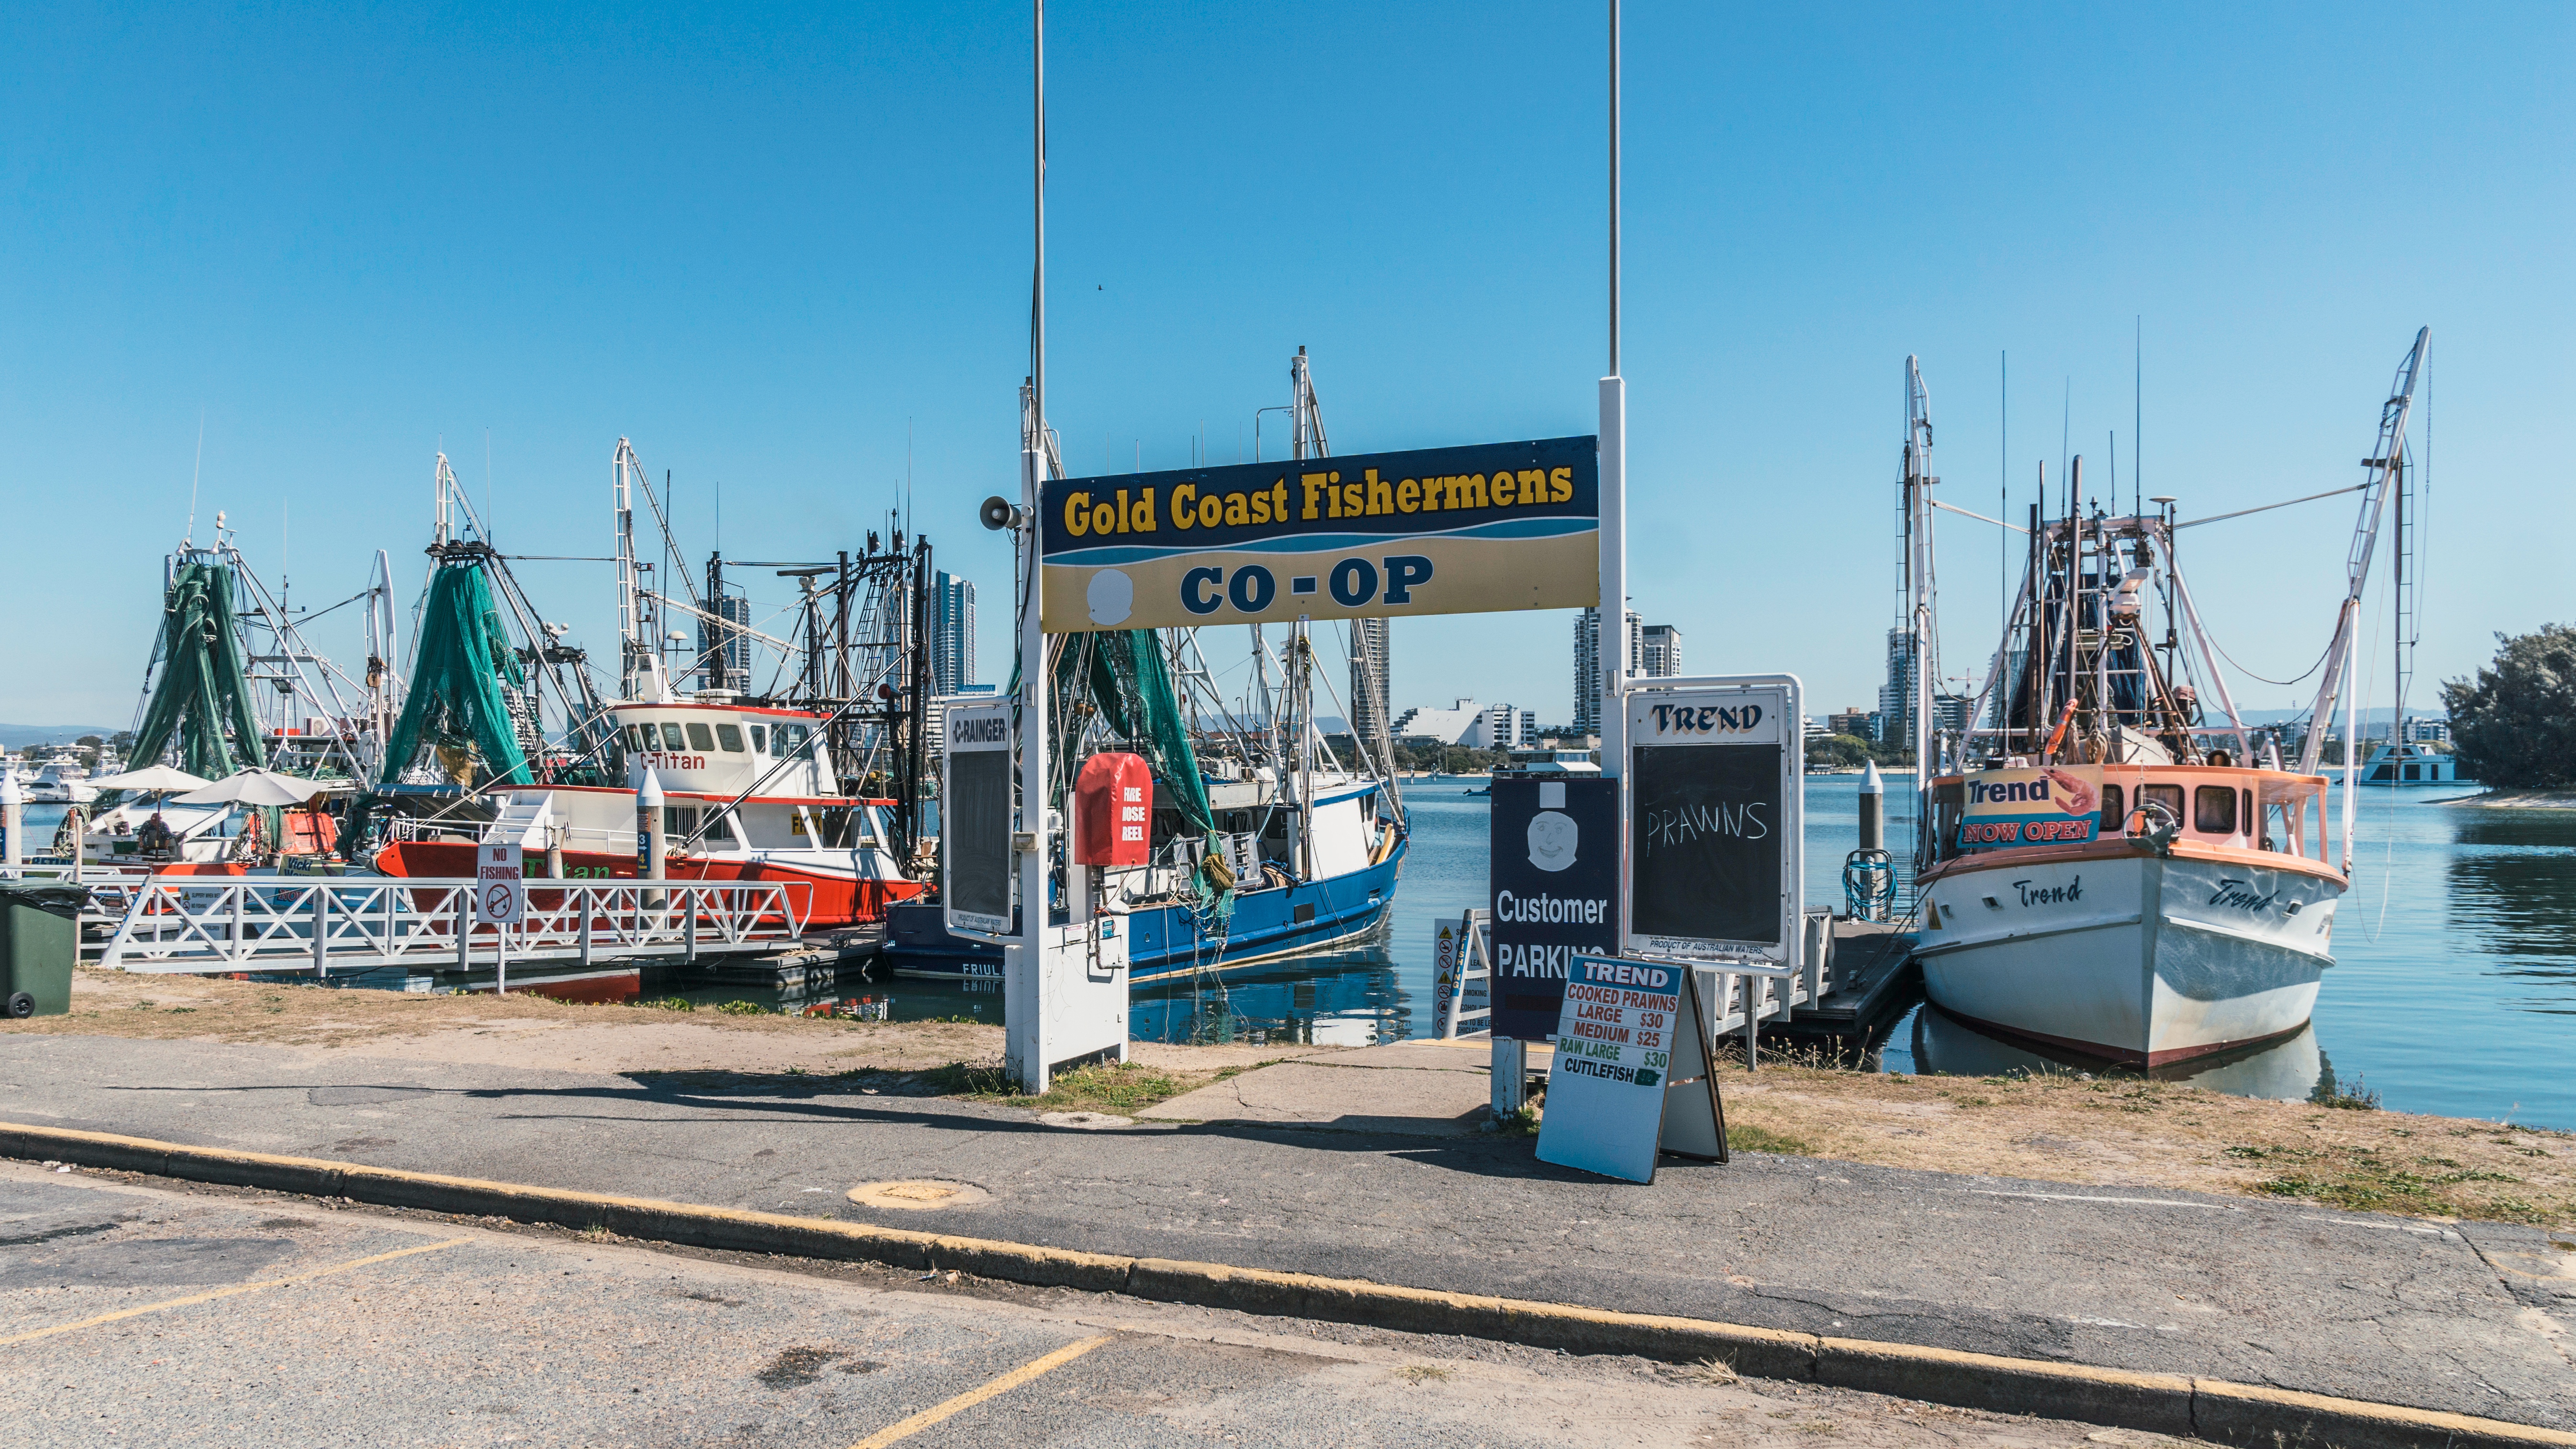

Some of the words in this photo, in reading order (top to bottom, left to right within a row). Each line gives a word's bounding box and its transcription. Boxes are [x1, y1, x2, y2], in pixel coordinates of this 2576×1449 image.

[1064, 487, 1157, 537] Gold
[1171, 483, 1288, 531] Coast
[1302, 464, 1573, 519] Fishermens
[955, 718, 1005, 744] C-RAINGER
[1650, 704, 1763, 735] TREND
[640, 752, 705, 770] C-Titan
[1123, 787, 1142, 802] FIRE
[1968, 775, 2050, 804] Trend
[1122, 806, 1145, 822] HOSE
[638, 834, 646, 845] 3
[1122, 826, 1144, 841] REEL
[1647, 801, 1767, 857] PRAWNS
[1964, 822, 2020, 844] NOW
[2023, 819, 2092, 842] OPEN
[288, 857, 313, 871] Vicki
[493, 848, 507, 861] NO
[638, 853, 645, 864] 4
[480, 866, 519, 880] FISHING
[522, 857, 610, 879] Ttan
[2012, 875, 2083, 907] Trend
[2209, 879, 2280, 912] Trend
[1497, 889, 1607, 924] Customer
[1650, 940, 1681, 949] PRODUCT
[1693, 943, 1734, 953] AUSTRALIAN
[1735, 945, 1763, 955] WATERS
[1453, 936, 1467, 988] FISHING
[1498, 944, 1605, 979] PARKI
[1583, 961, 1669, 989] TREND
[1463, 989, 1487, 997] SMOKING
[1567, 983, 1619, 1005] COOKED
[1622, 990, 1677, 1012] PRAWNS
[1577, 1003, 1623, 1023] LARGE
[1640, 1012, 1663, 1029] $30
[1573, 1021, 1630, 1043] MEDIUM
[1636, 1031, 1661, 1047] $25
[1559, 1038, 1585, 1055] RAW
[1585, 1042, 1621, 1061] LARGE
[1644, 1051, 1667, 1068] $30
[1564, 1057, 1635, 1083] CUTTLEFISH
